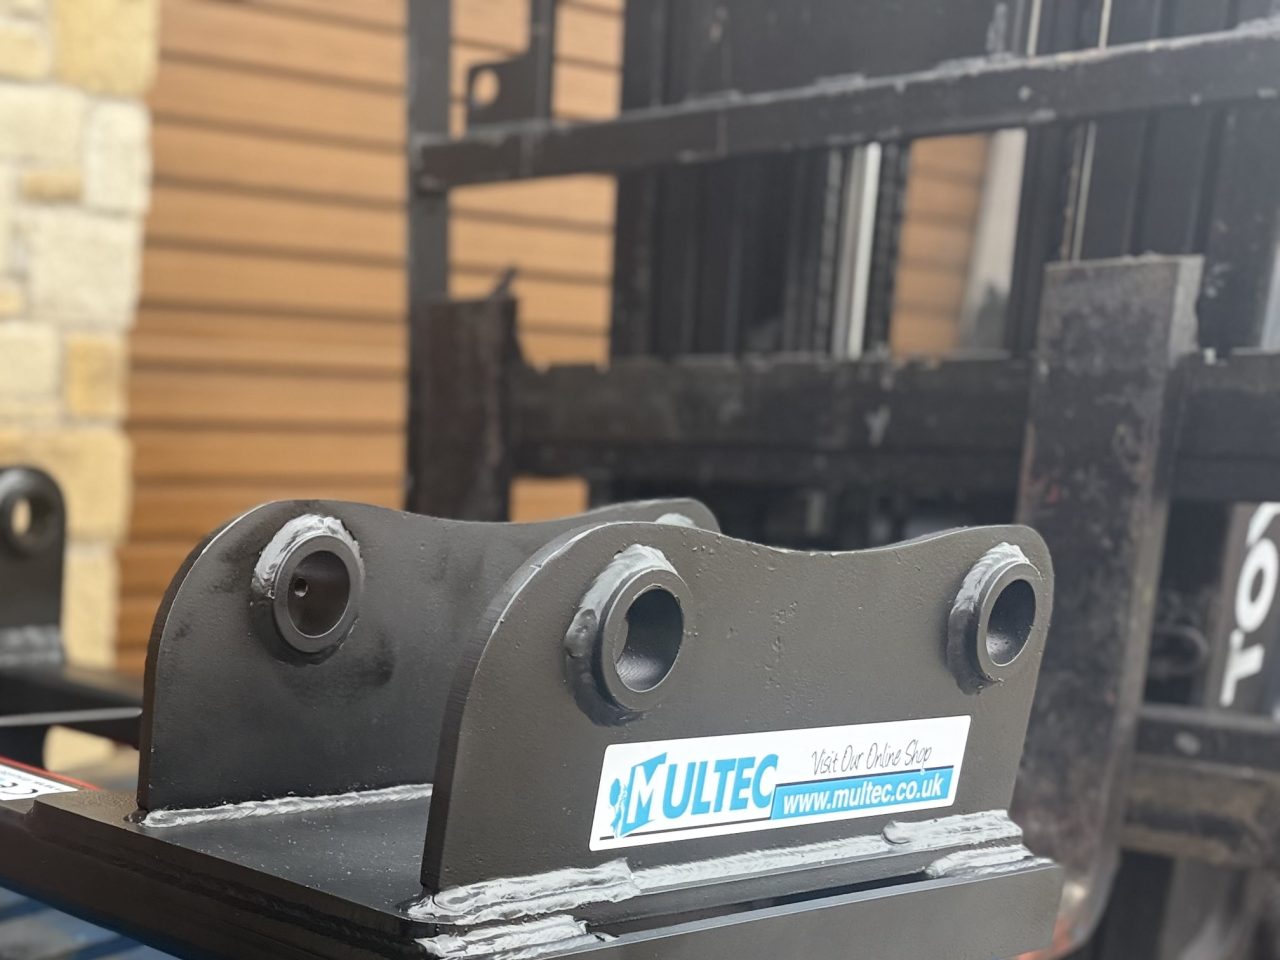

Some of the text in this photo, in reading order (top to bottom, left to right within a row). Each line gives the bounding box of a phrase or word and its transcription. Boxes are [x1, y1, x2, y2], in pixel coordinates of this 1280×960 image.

[812, 739, 933, 775] Visit Our Online Shop
[622, 752, 779, 833] MULTEC
[783, 773, 945, 815] www.multec.co.uk
